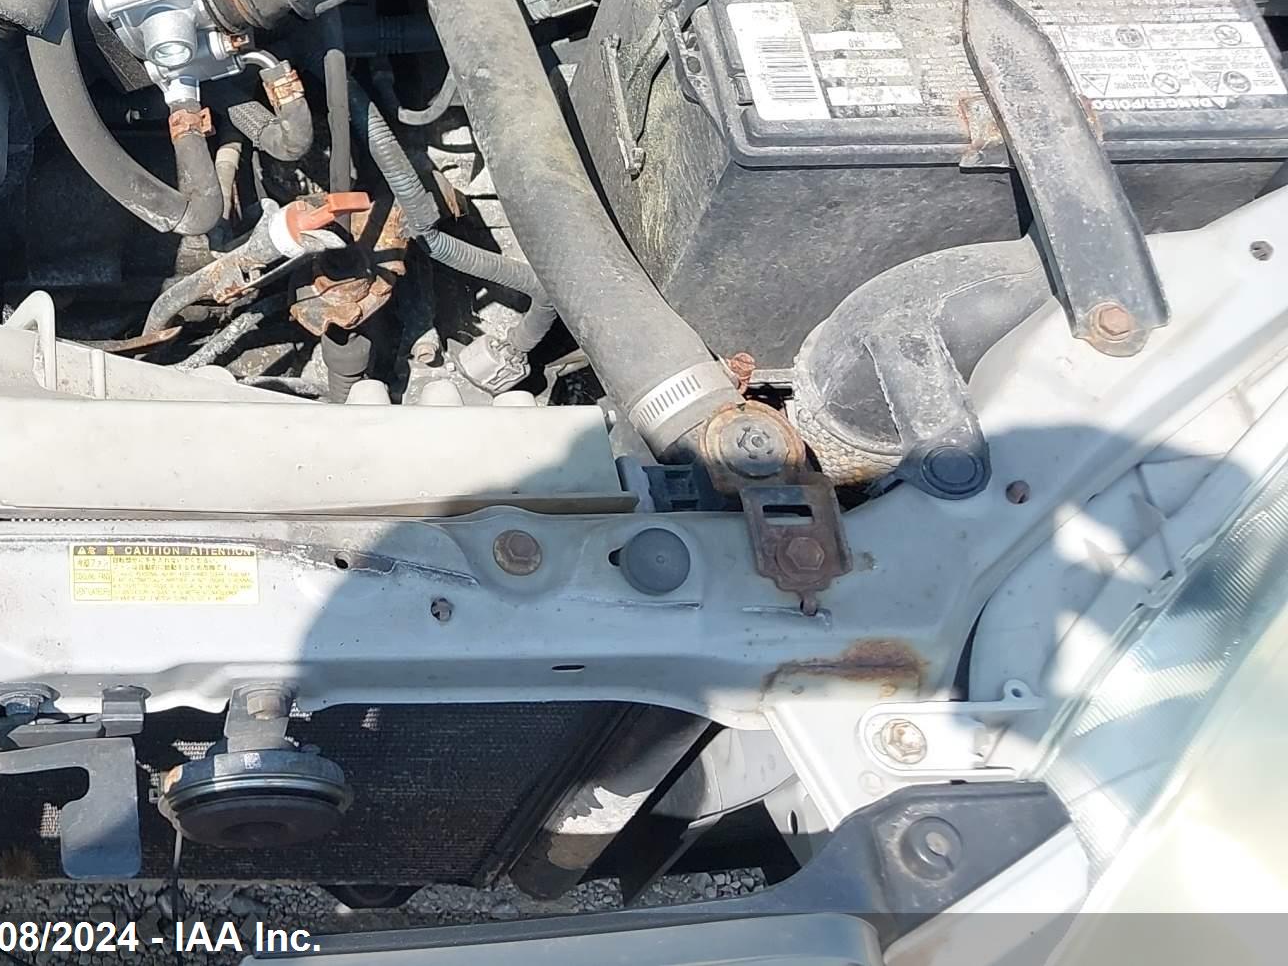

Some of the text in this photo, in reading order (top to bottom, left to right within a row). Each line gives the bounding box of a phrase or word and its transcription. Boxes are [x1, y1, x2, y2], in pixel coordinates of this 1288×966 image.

[1092, 97, 1213, 111] DANGER/POISO
[124, 546, 180, 555] CAUTION
[190, 546, 252, 556] ATTENTION
